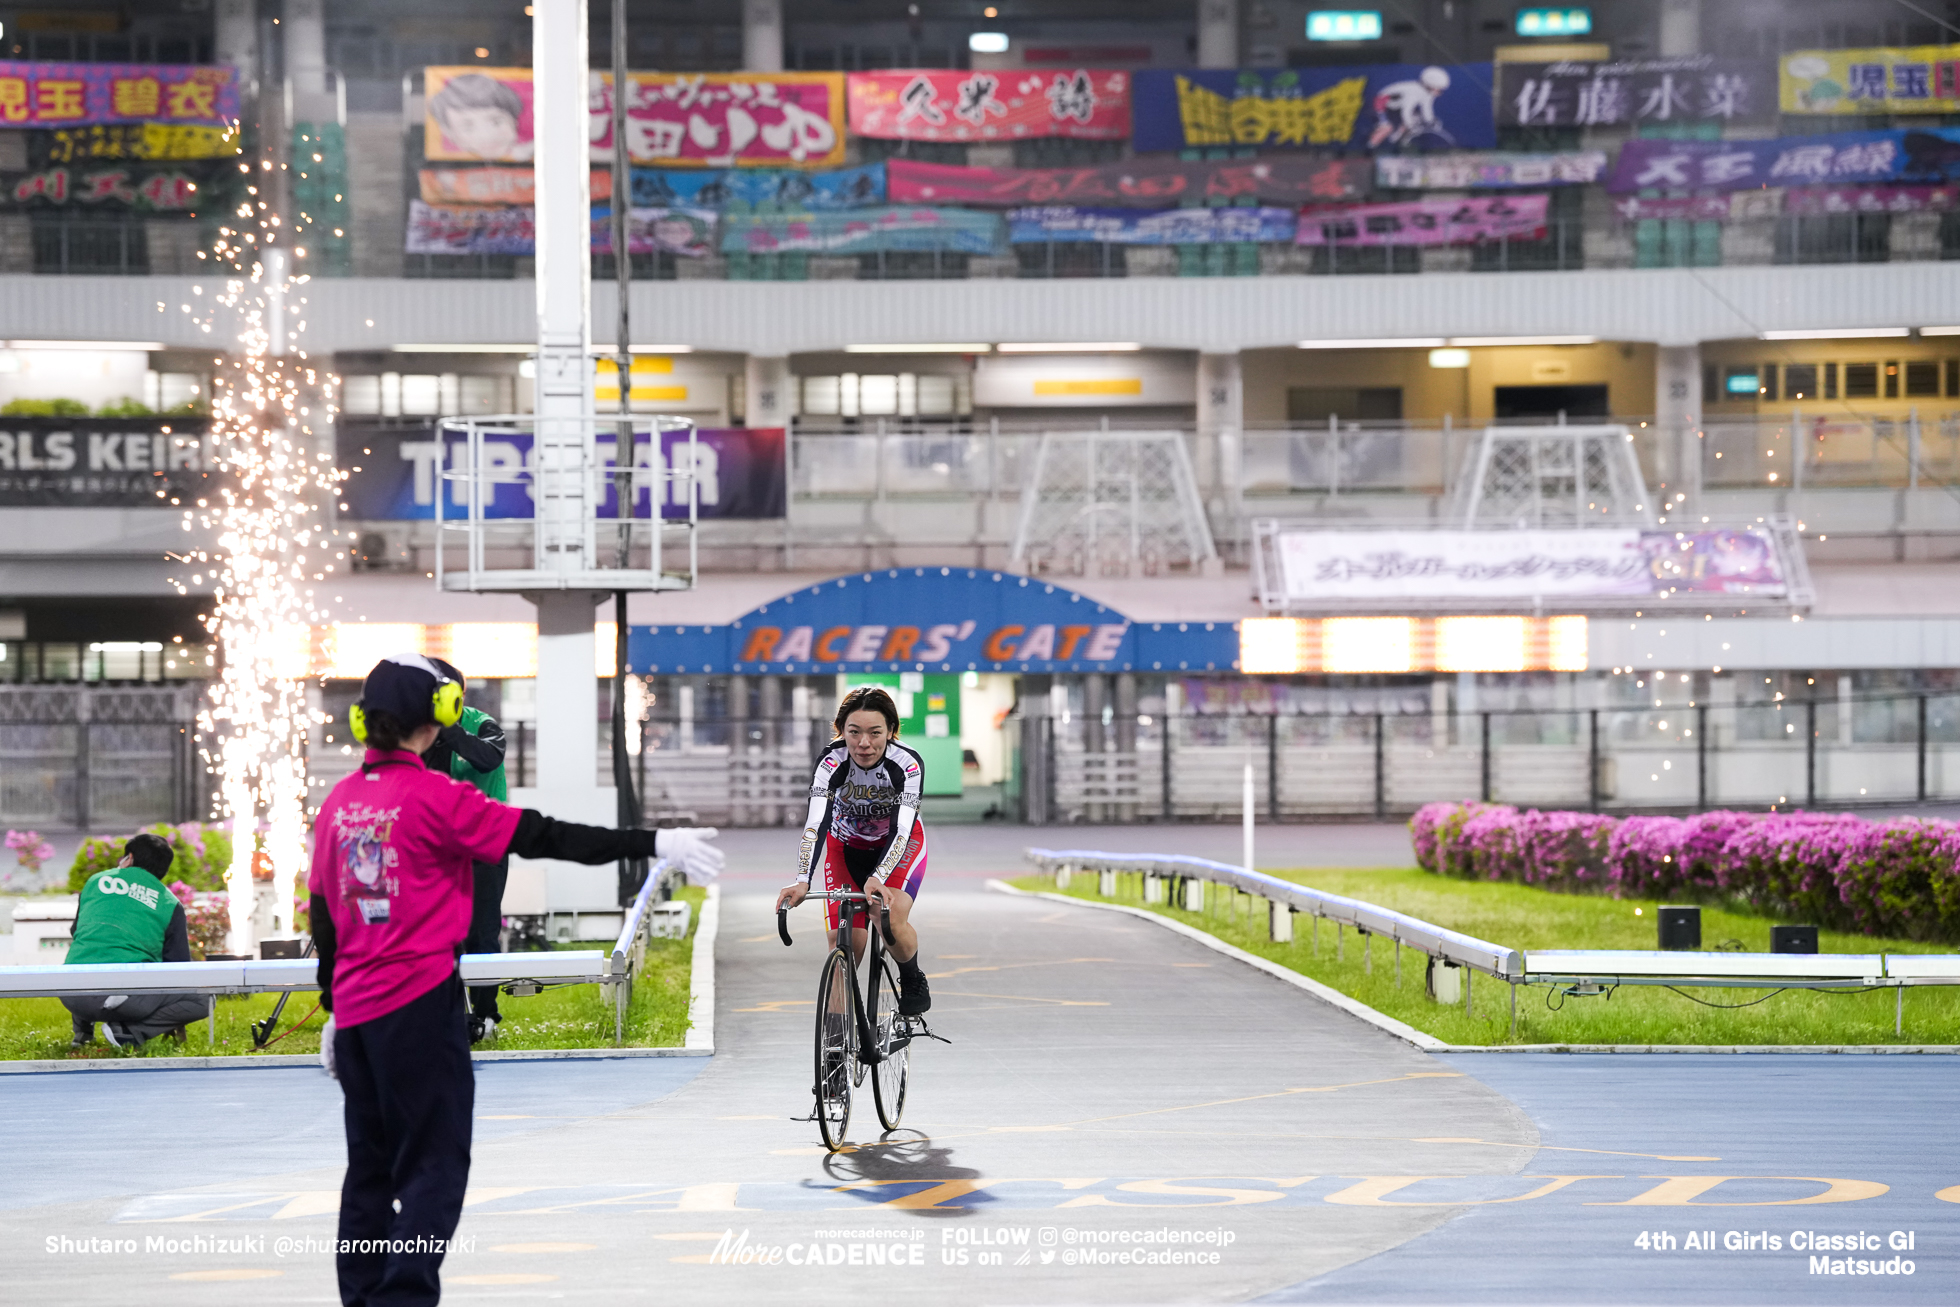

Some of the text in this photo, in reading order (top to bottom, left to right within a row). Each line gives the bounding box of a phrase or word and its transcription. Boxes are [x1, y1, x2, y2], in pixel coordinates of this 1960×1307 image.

[1515, 74, 1750, 126] 佐藤水菜
[741, 620, 1128, 663] RACERS' GATE
[798, 828, 819, 875] Queen
[876, 834, 907, 880] Queen
